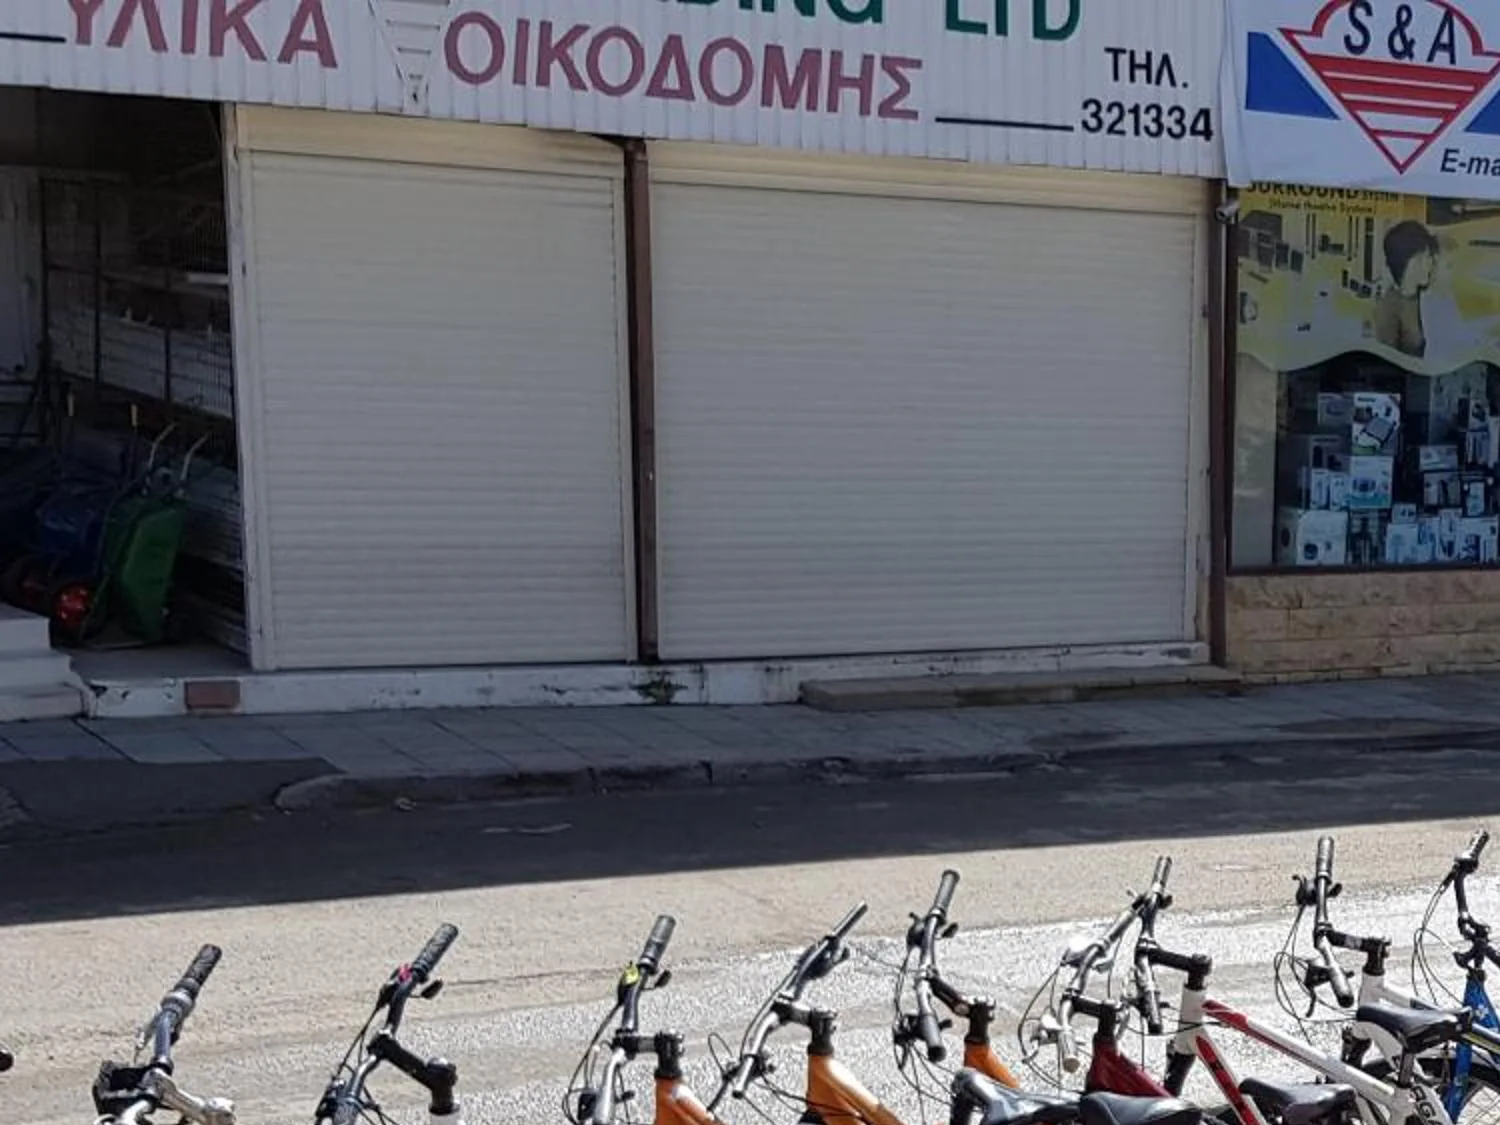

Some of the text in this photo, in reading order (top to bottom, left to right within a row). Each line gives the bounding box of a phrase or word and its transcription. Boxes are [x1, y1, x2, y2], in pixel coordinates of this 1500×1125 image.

[444, 11, 922, 120] ΟΙΚΟΔΟΜΗΣ
[1104, 47, 1188, 88] ΤΗΛ.
[1081, 98, 1213, 141] 321334
